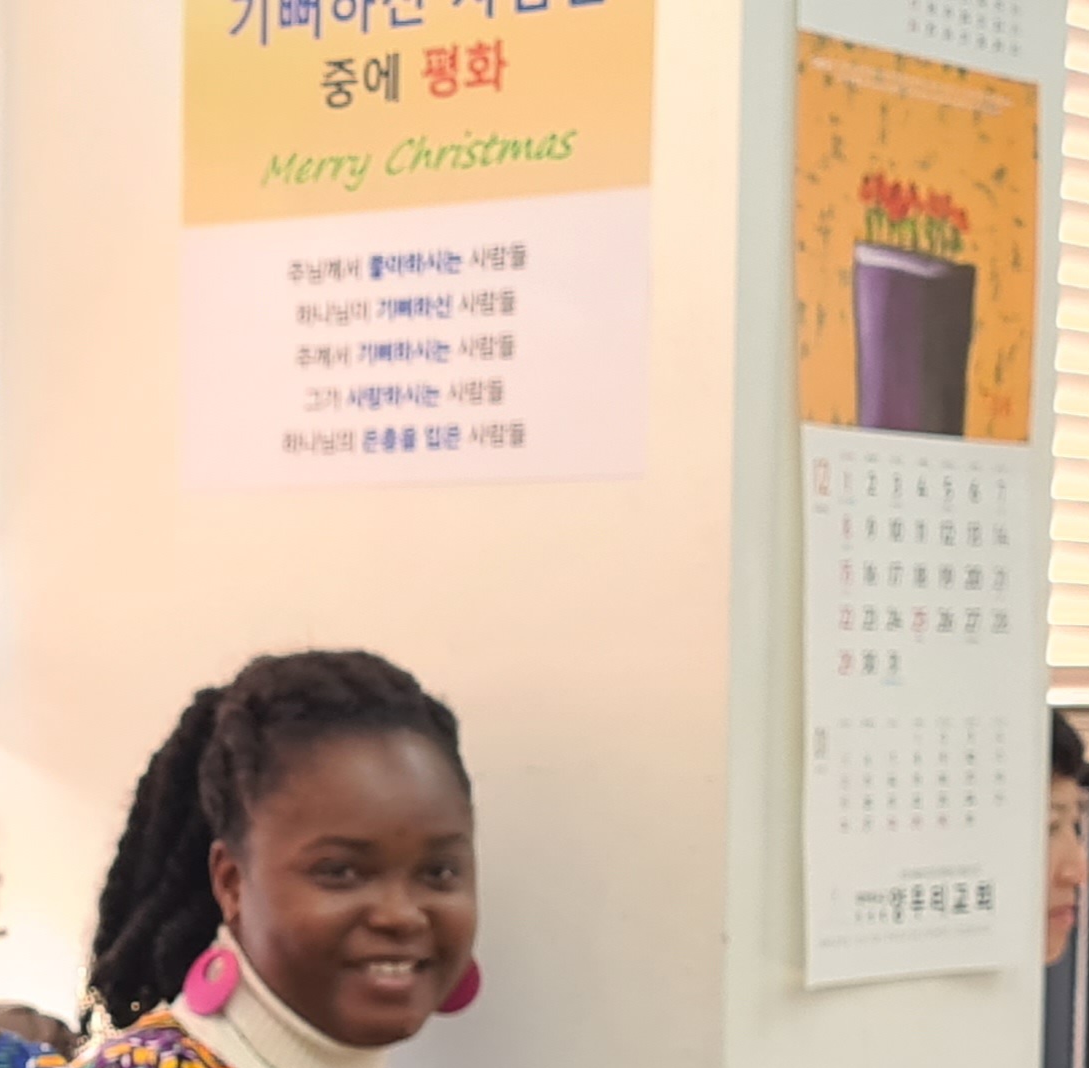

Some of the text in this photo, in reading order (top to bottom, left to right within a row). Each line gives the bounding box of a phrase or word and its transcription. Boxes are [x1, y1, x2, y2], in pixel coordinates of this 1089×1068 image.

[321, 38, 509, 109] 중에 평화
[261, 129, 578, 191] Merry Christmas
[470, 243, 526, 270] 사람들
[460, 289, 515, 316] 사람들
[459, 333, 515, 360] 사람들
[448, 379, 503, 405] 사람들
[470, 421, 526, 448] 사람들
